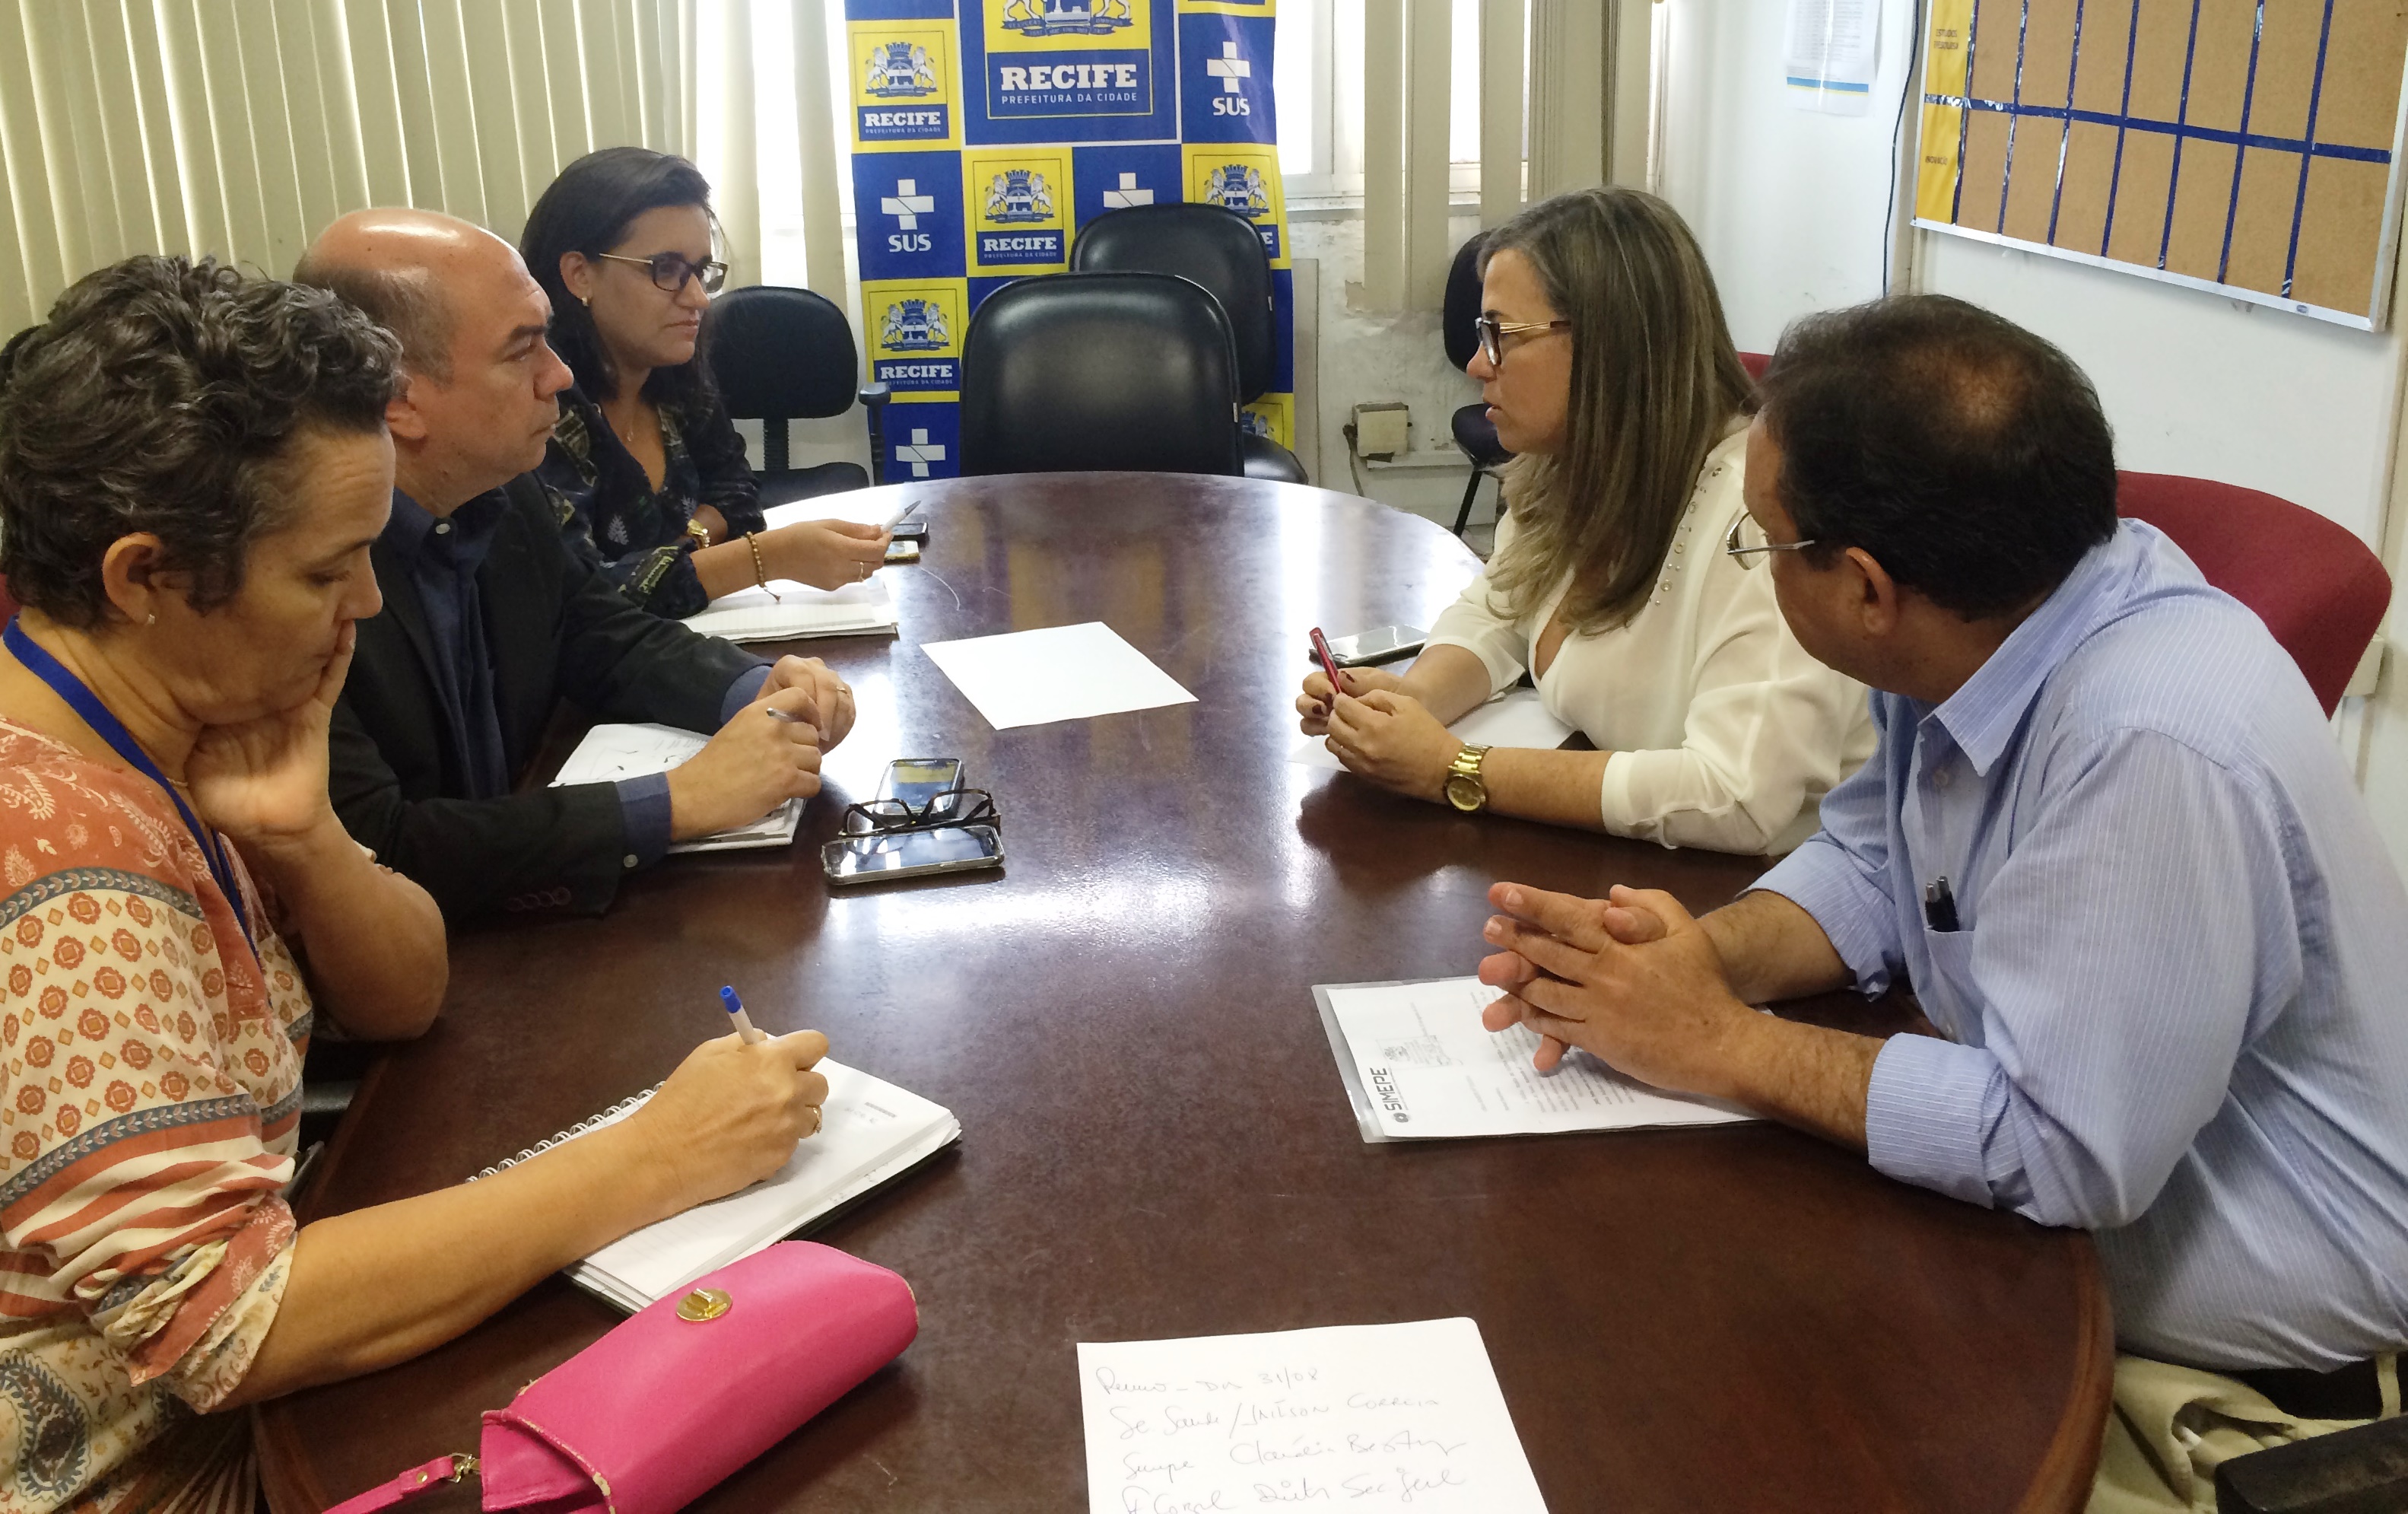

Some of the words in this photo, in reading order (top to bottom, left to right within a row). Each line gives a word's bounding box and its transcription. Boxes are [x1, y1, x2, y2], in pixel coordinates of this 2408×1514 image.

[1000, 64, 1137, 91] RECIFE
[1002, 94, 1072, 104] PREFEITURA
[1077, 93, 1092, 103] DA
[1098, 92, 1137, 102] CIDADE
[1212, 97, 1250, 116] SUS
[864, 111, 941, 126] RECIFE
[888, 234, 932, 252] SUS
[983, 237, 1057, 251] RECIFE
[880, 365, 953, 379] RECIFE
[1370, 1067, 1403, 1111] SIMEPE
[1259, 1366, 1318, 1390] 31/08
